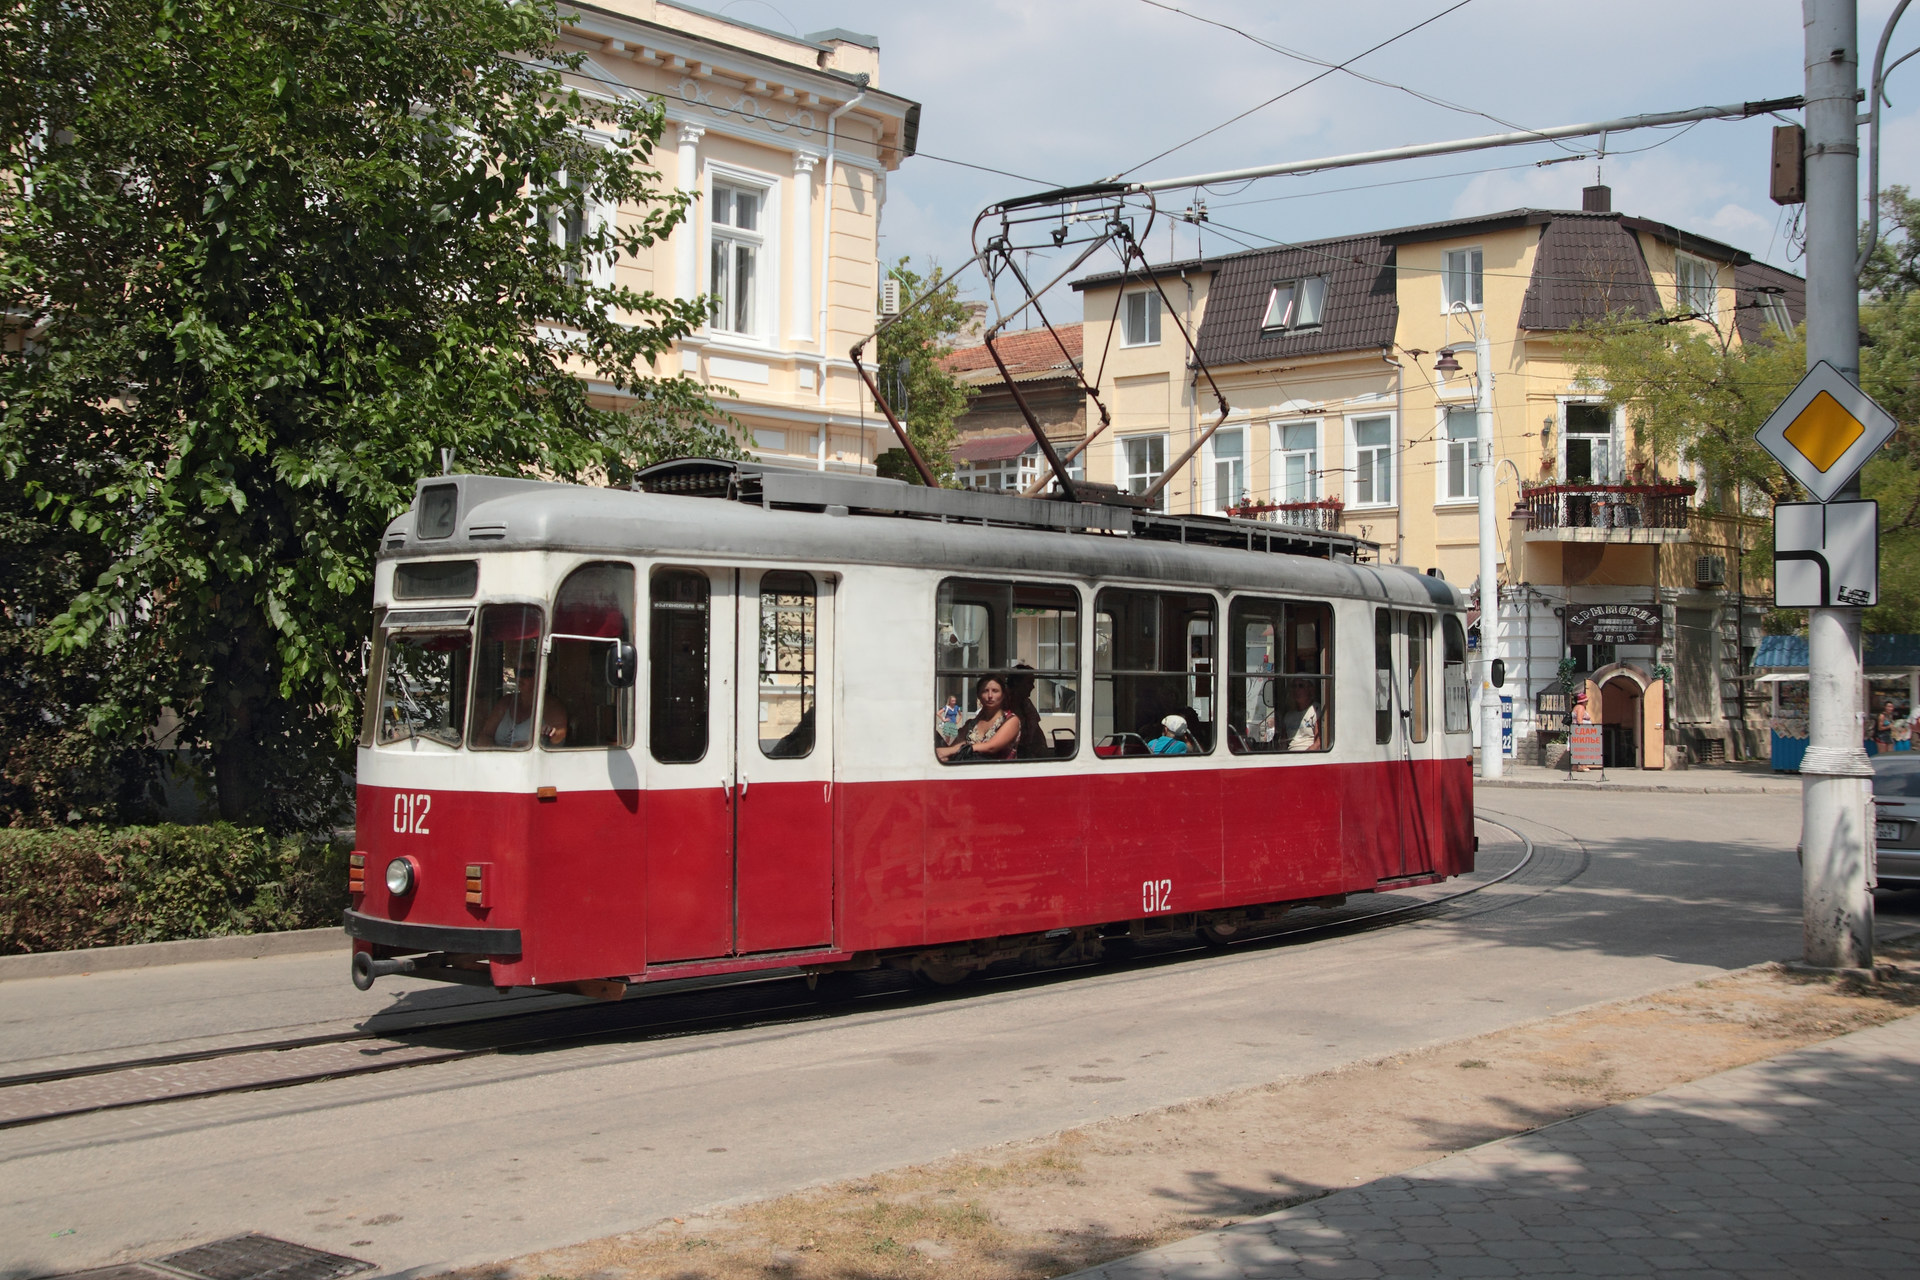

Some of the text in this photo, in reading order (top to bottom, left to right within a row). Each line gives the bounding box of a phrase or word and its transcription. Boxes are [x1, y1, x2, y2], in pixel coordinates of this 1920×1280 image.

[437, 499, 452, 527] 2
[1570, 605, 1660, 625] КРЫМСКИЕ
[1594, 633, 1637, 643] ВИНА
[1540, 694, 1565, 712] ВИНА
[1575, 727, 1597, 736] СДАМ
[393, 792, 432, 835] 012
[1142, 878, 1172, 914] 012
